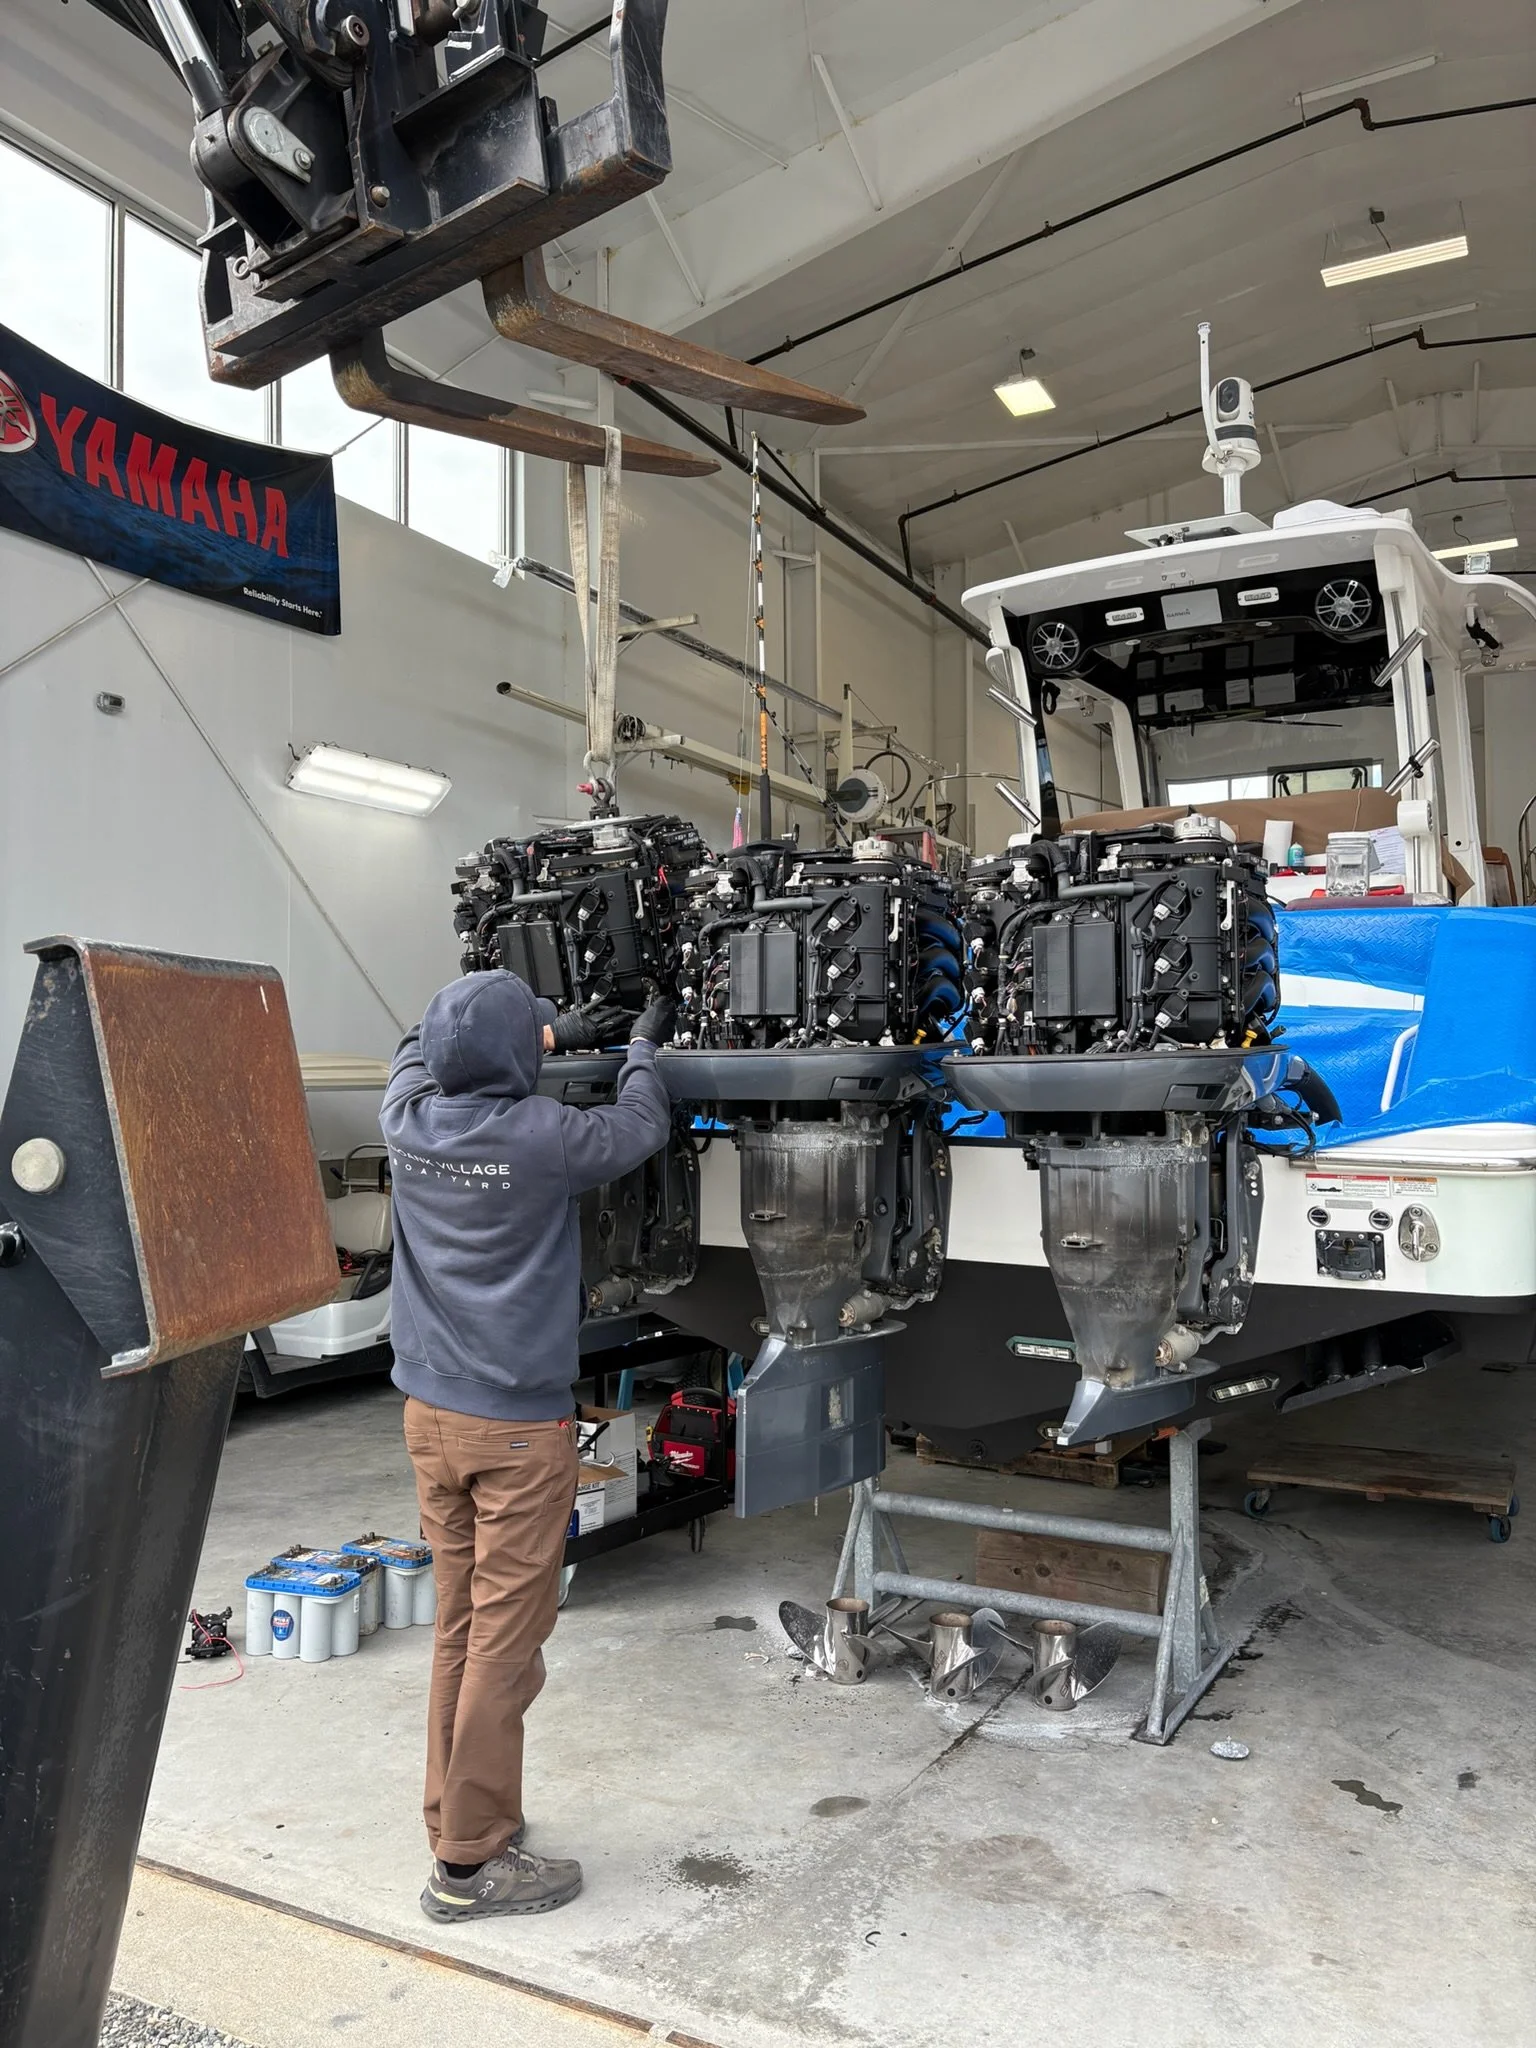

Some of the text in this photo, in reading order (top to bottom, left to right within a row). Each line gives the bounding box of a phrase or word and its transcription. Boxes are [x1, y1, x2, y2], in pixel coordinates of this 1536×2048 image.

[40, 392, 289, 559] YAMAHA
[243, 586, 280, 606] Reliability
[281, 598, 302, 612] Starts
[436, 1161, 511, 1176] VILLAGE
